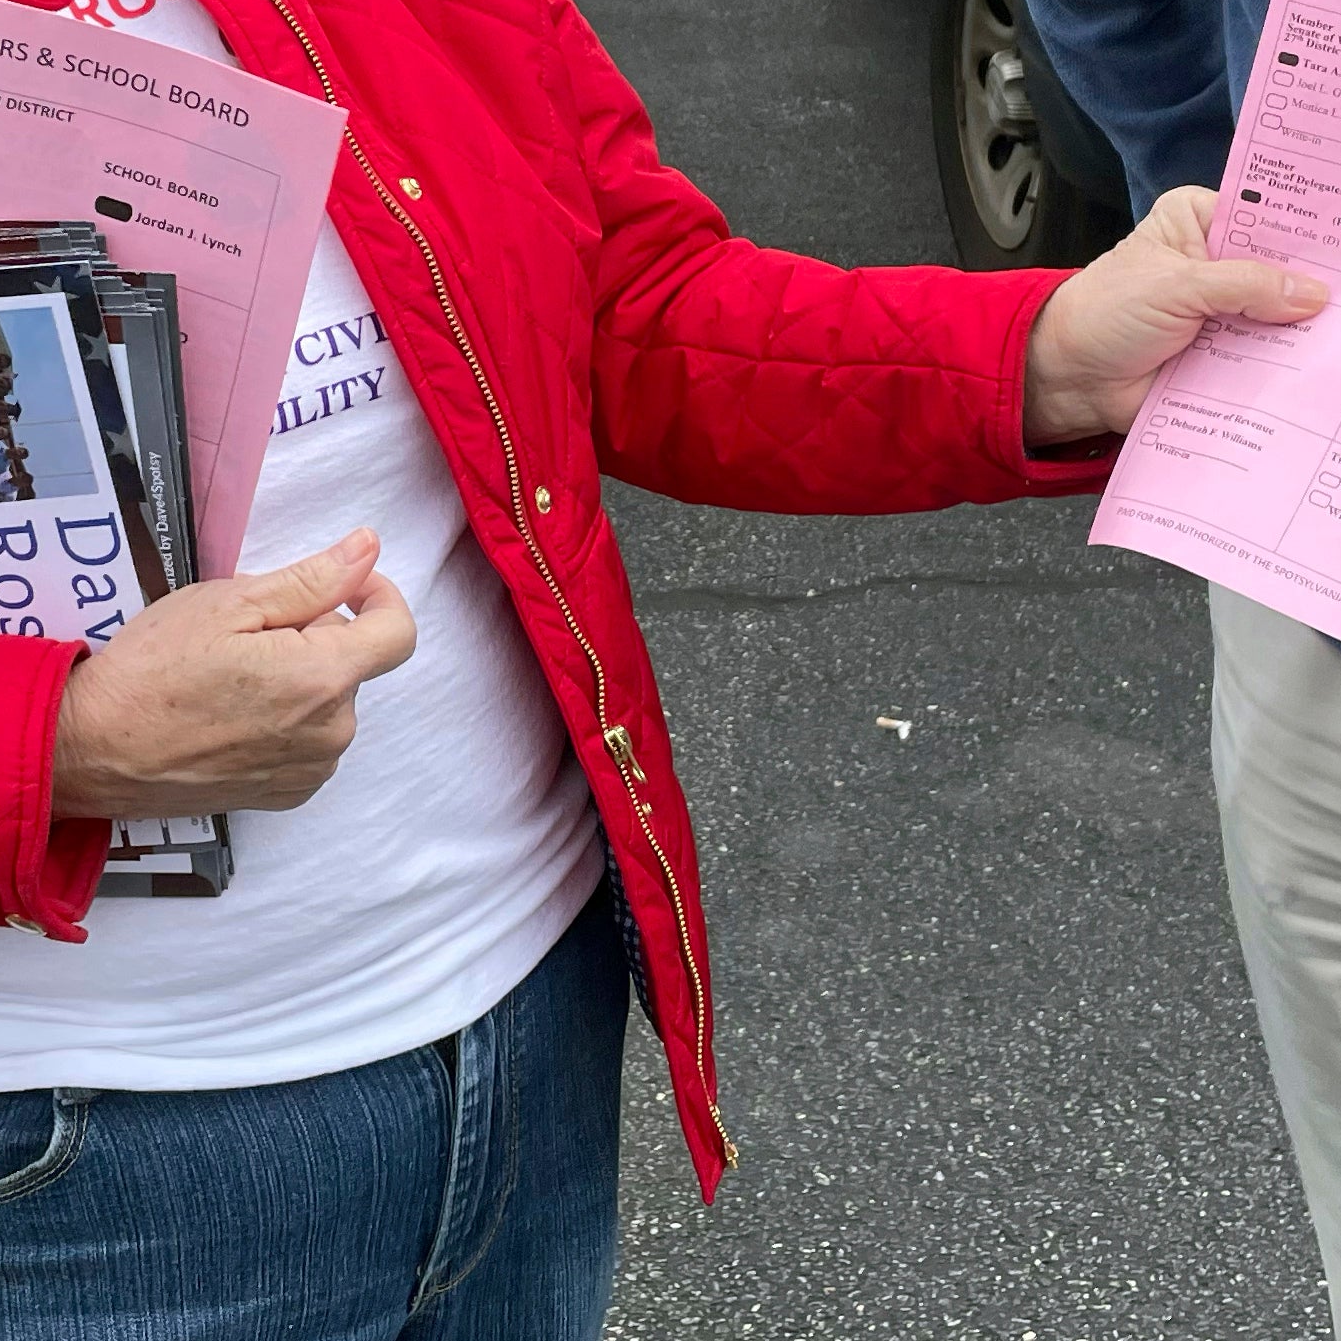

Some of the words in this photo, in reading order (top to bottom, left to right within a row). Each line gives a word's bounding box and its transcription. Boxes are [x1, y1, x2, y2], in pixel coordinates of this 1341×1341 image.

[1286, 22, 1322, 40] Senate
[1290, 12, 1335, 32] Member
[1302, 57, 1328, 74] Tara
[37, 47, 55, 68] &
[63, 54, 161, 99] SCHOOL
[168, 84, 250, 128] BOARD
[6, 97, 76, 123] DISTRICT
[1248, 161, 1282, 180] House
[103, 161, 164, 190] SCHOOL
[167, 181, 219, 208] BOARD
[1285, 202, 1318, 220] Peters
[135, 212, 184, 236] Jordan
[187, 228, 197, 241] J.
[202, 233, 242, 258] Lynch
[270, 366, 385, 436] ILITY
[149, 451, 169, 532] Dave4Spotsy
[159, 534, 173, 550] by
[55, 512, 125, 642] Dav
